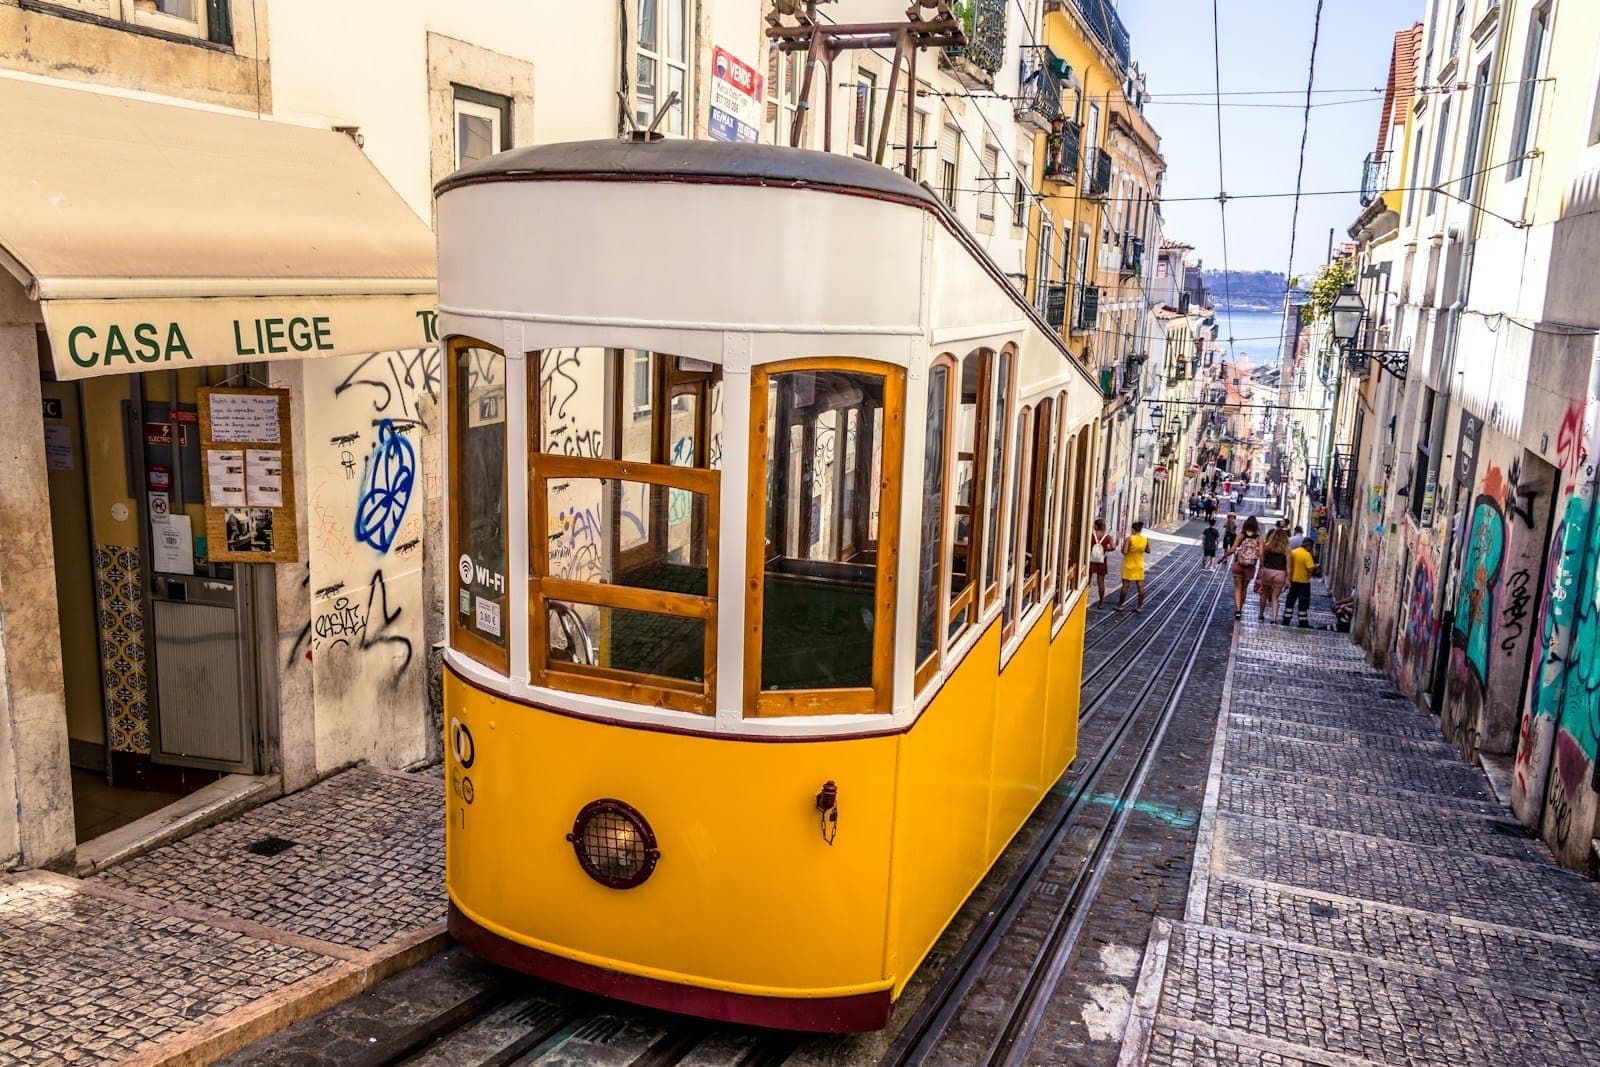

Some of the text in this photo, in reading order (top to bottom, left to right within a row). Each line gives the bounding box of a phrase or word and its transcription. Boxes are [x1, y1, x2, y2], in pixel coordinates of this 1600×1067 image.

[730, 62, 752, 88] VENDE
[712, 108, 734, 129] RE/MAX
[68, 322, 193, 368] CASA
[233, 316, 334, 356] LIEGE
[476, 564, 505, 594] WI-FI
